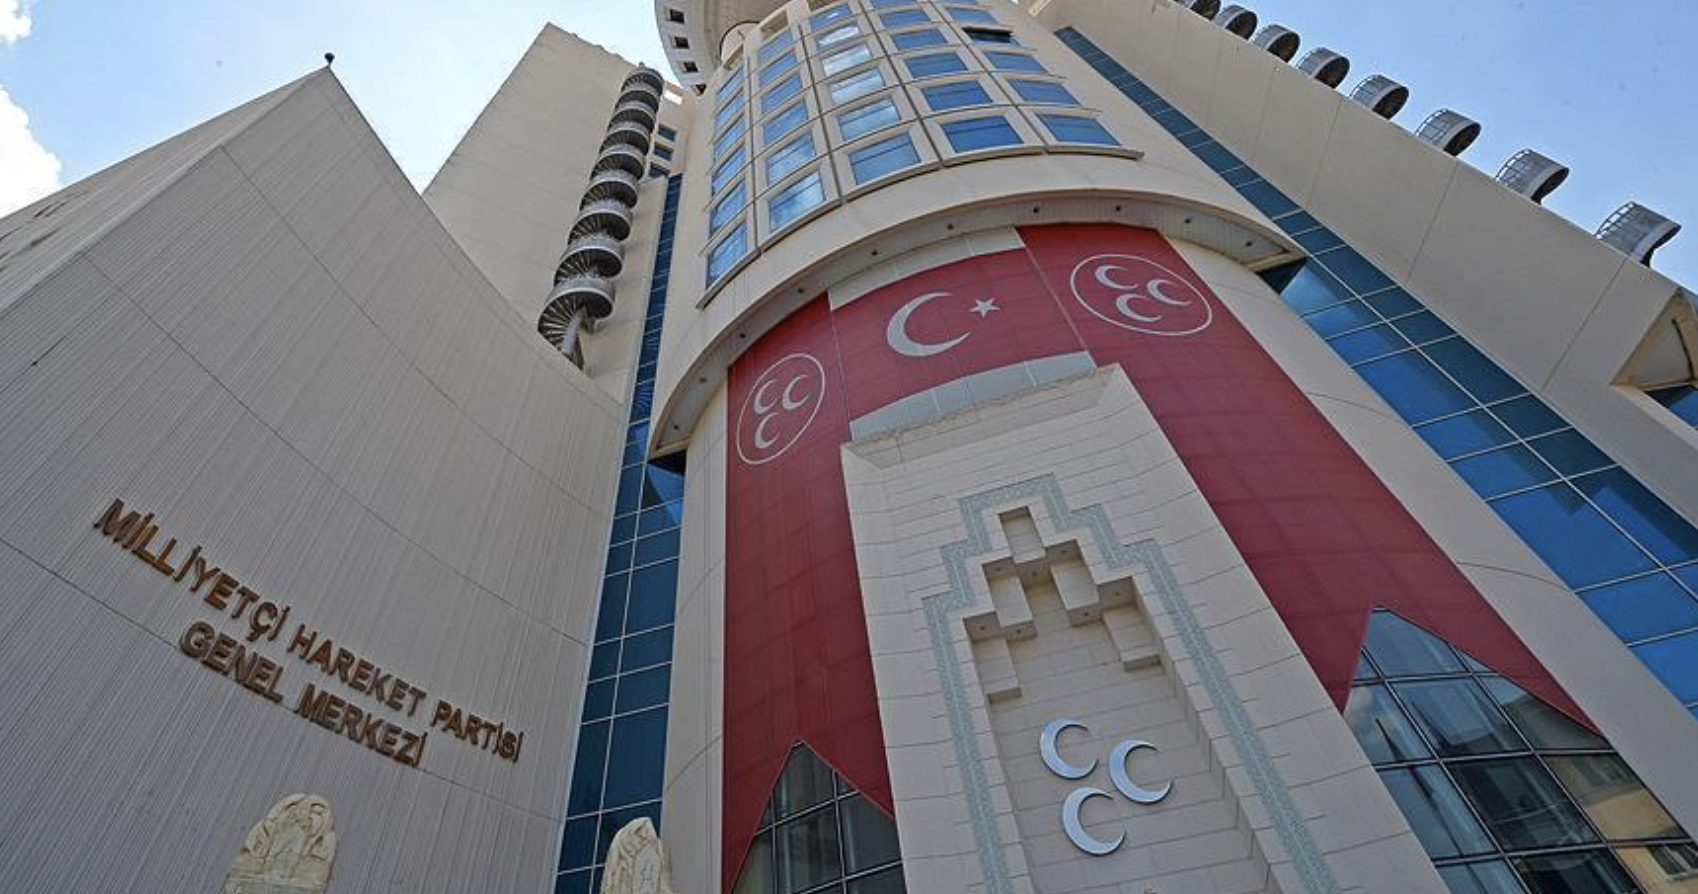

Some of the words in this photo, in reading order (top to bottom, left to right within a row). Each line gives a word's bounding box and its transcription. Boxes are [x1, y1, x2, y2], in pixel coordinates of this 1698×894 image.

[93, 498, 290, 642] MİLLİYETÇİ
[287, 624, 427, 718] HAREKET
[429, 699, 524, 763] PARTİSİ
[178, 621, 285, 703] GENEL
[294, 683, 428, 768] MERKEZİ
